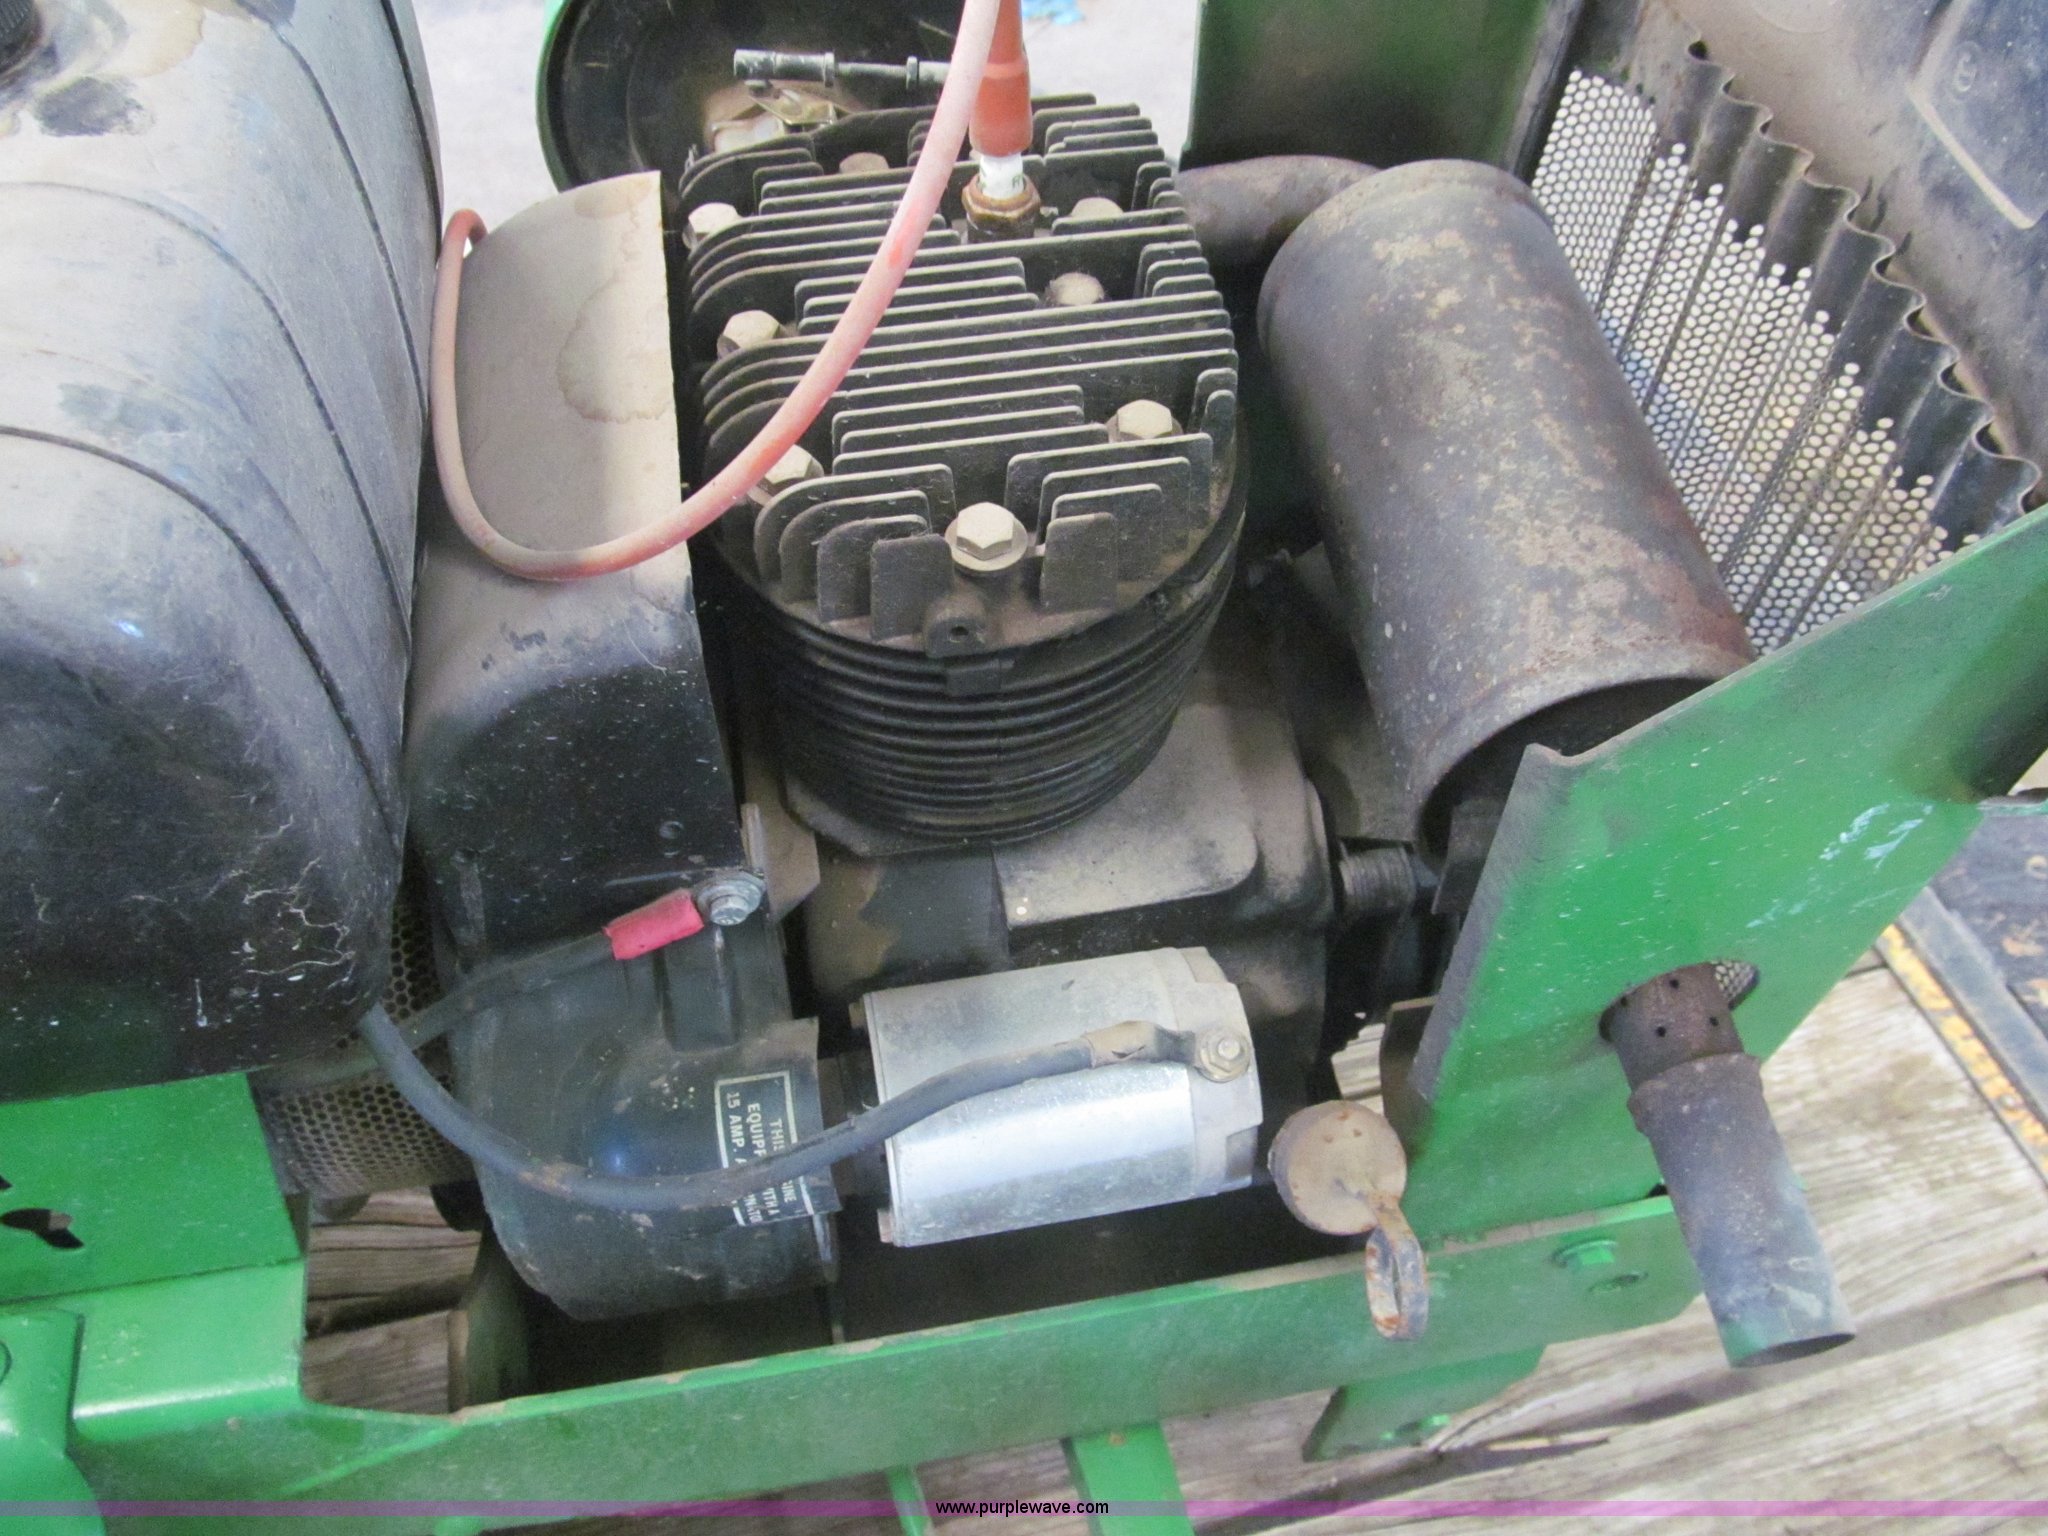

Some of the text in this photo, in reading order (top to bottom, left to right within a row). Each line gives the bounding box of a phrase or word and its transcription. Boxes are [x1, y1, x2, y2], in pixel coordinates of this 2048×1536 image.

[727, 1092, 741, 1109] 15
[729, 1115, 745, 1153] AMP.
[746, 1103, 767, 1157] EQUIPP
